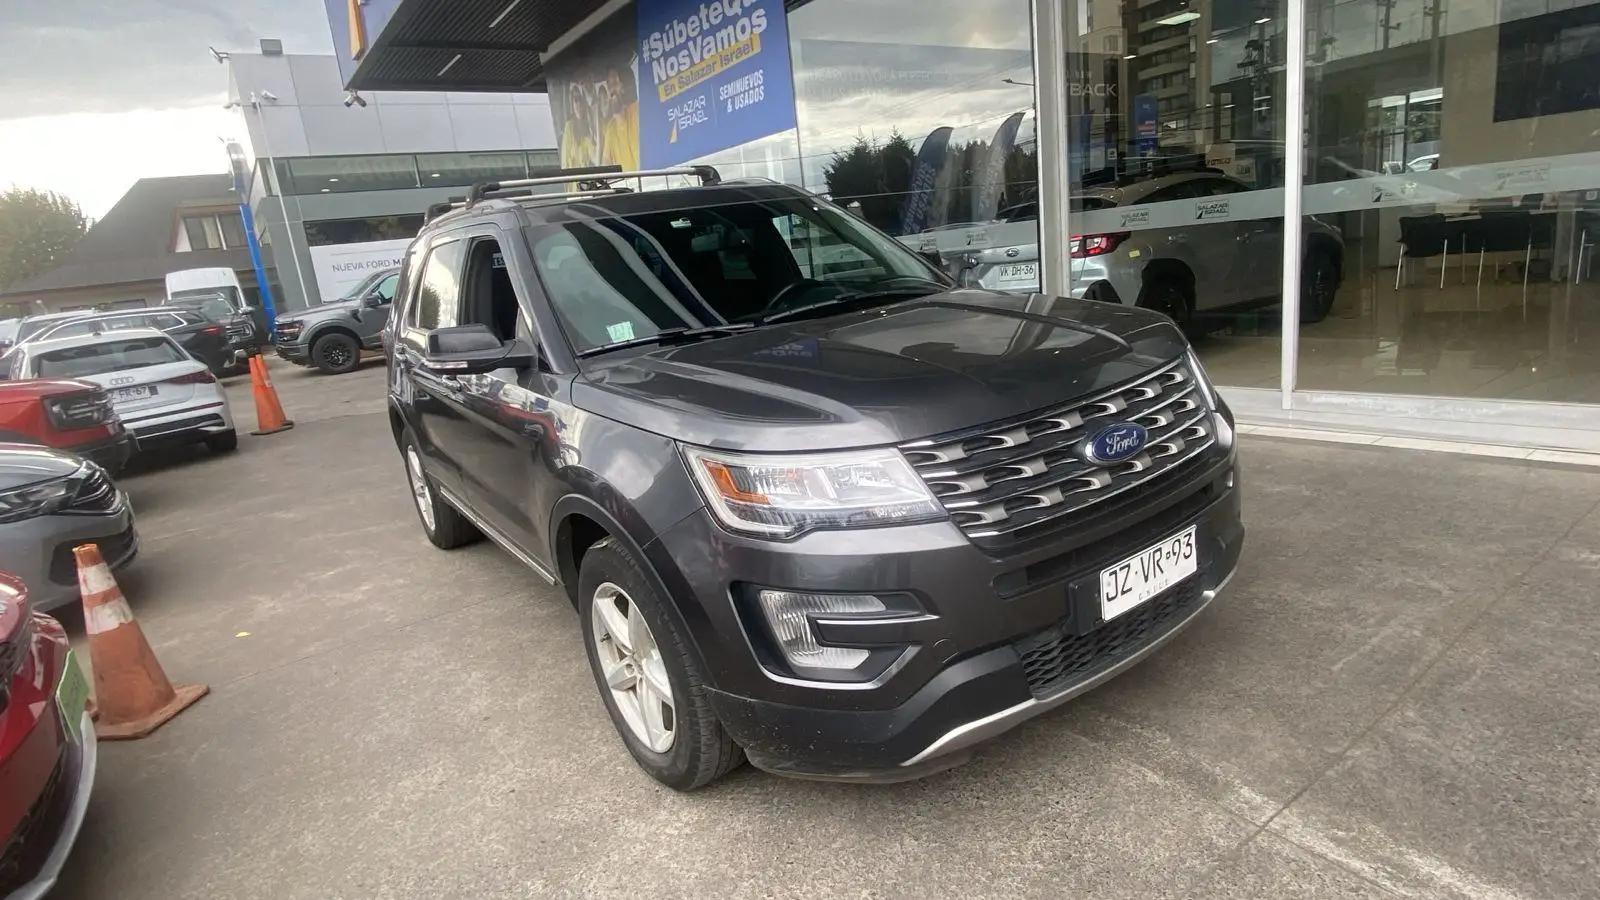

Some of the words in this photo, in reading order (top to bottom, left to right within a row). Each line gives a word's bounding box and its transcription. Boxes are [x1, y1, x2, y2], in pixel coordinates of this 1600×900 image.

[653, 9, 768, 84] NosVamos
[664, 84, 677, 96] En
[678, 61, 717, 90] Salazar
[719, 43, 755, 68] Israel
[719, 69, 764, 100] SEMINUEVOS
[667, 95, 706, 120] SALAZAR
[727, 98, 733, 112] &
[735, 86, 764, 110] USADOS
[679, 110, 708, 129] ISRAEL
[332, 262, 365, 272] NUEVA
[366, 259, 391, 269] FORD
[1106, 429, 1139, 455] Ford
